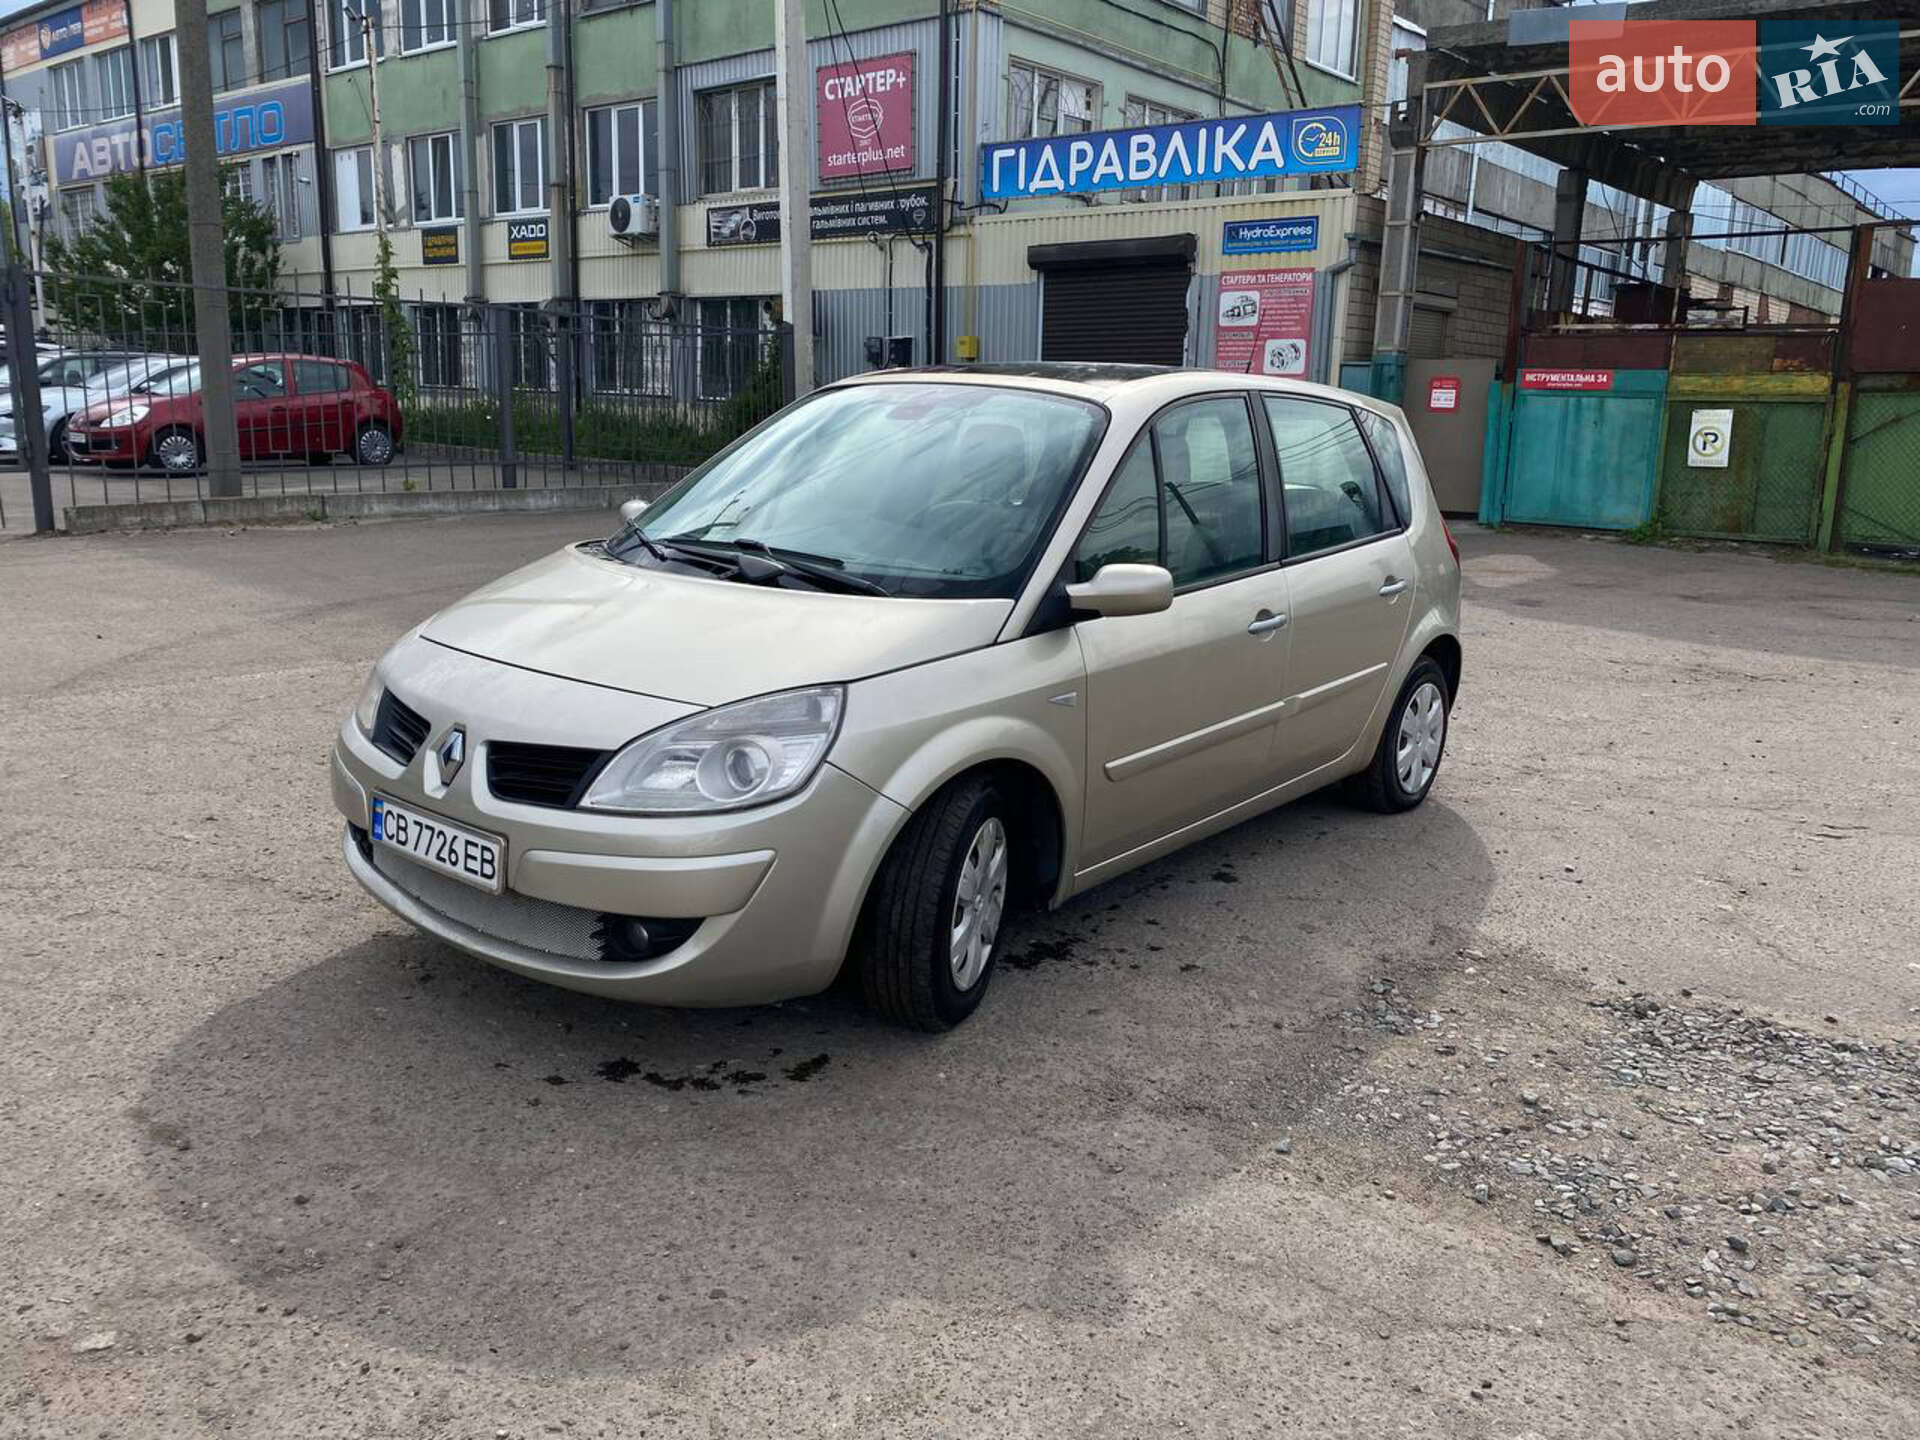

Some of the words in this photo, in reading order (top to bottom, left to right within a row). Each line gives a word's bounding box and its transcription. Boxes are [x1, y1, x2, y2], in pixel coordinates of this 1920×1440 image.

[825, 68, 907, 100] СТАРТЕР+
[72, 100, 285, 179] АВТОСТЛО
[1319, 131, 1341, 147] 24h
[828, 144, 905, 167] starterplus.net
[992, 120, 1285, 193] ГІДРАВЛІКА
[1239, 225, 1313, 241] HydroExpress
[1222, 275, 1256, 286] СТАРТЕРИ
[1266, 272, 1313, 284] ГЕНЕРАТОРИ
[384, 810, 409, 847] CB
[413, 820, 459, 867] 7726
[464, 839, 496, 880] EB
